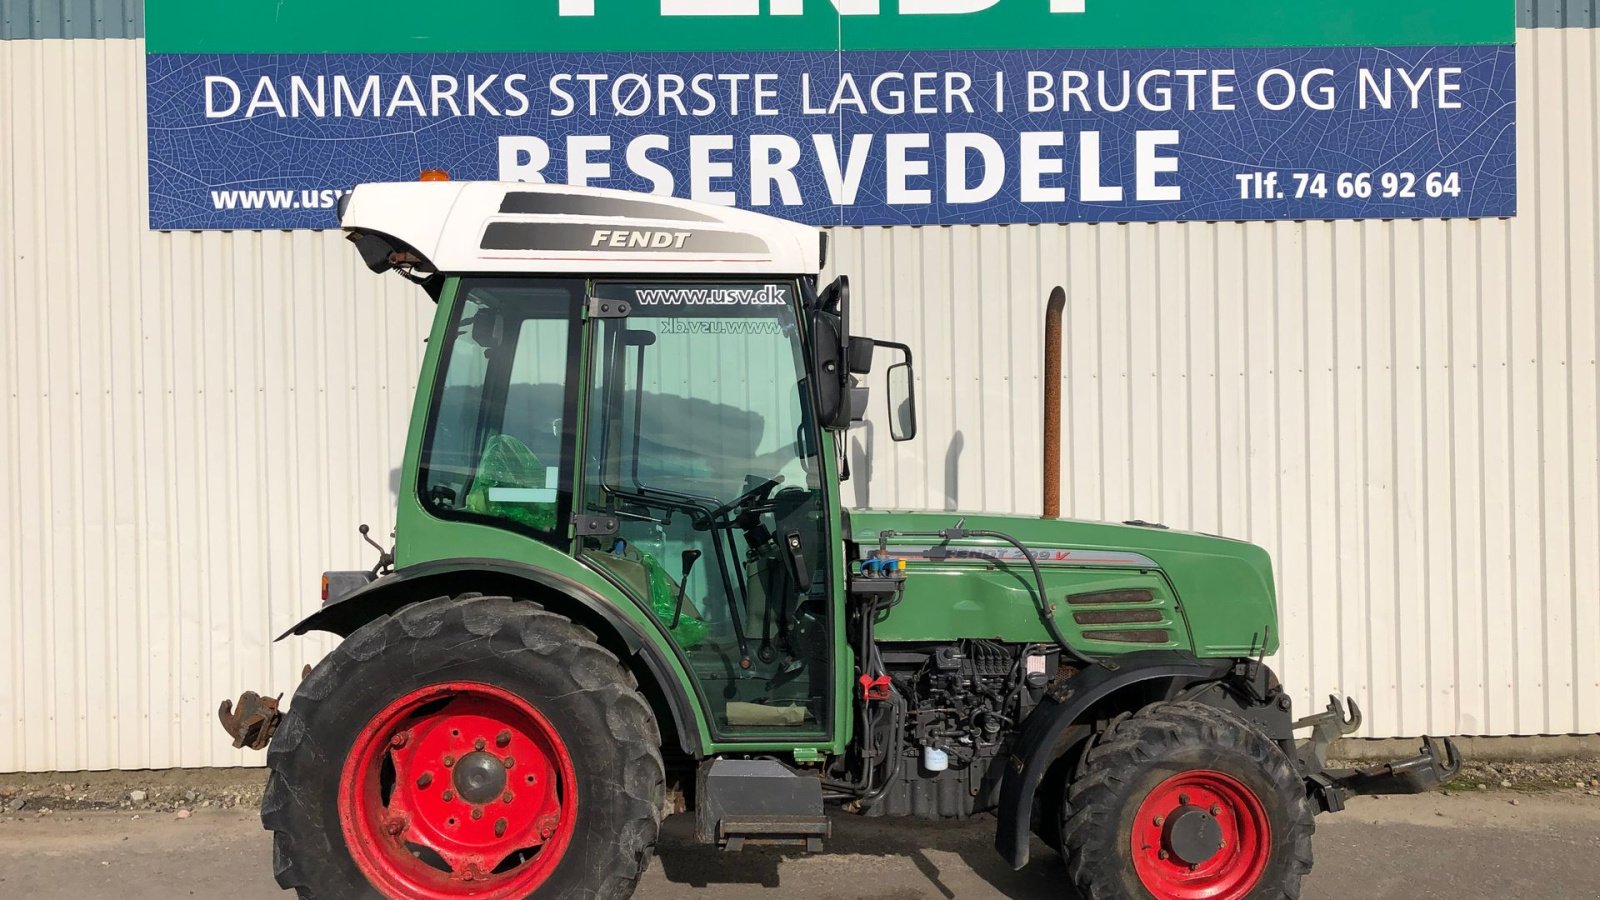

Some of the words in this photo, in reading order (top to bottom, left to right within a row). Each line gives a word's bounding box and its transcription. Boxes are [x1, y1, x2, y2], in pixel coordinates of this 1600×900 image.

[204, 73, 530, 118] DANMARKS
[549, 72, 779, 117] STØRSTE
[802, 71, 975, 115] LAGER
[995, 71, 1004, 113] I
[1027, 68, 1236, 113] BRUGTE
[1257, 67, 1336, 111] OG
[1359, 67, 1462, 110] NYE
[497, 130, 1181, 206] RESERVEDELE
[1236, 171, 1284, 200] Tlf.
[1292, 172, 1328, 199] 74
[1336, 172, 1374, 199] 66
[1381, 171, 1417, 199] 92
[1425, 171, 1462, 198] 64
[590, 229, 692, 249] FENDT
[635, 284, 787, 306] www.usv.dk
